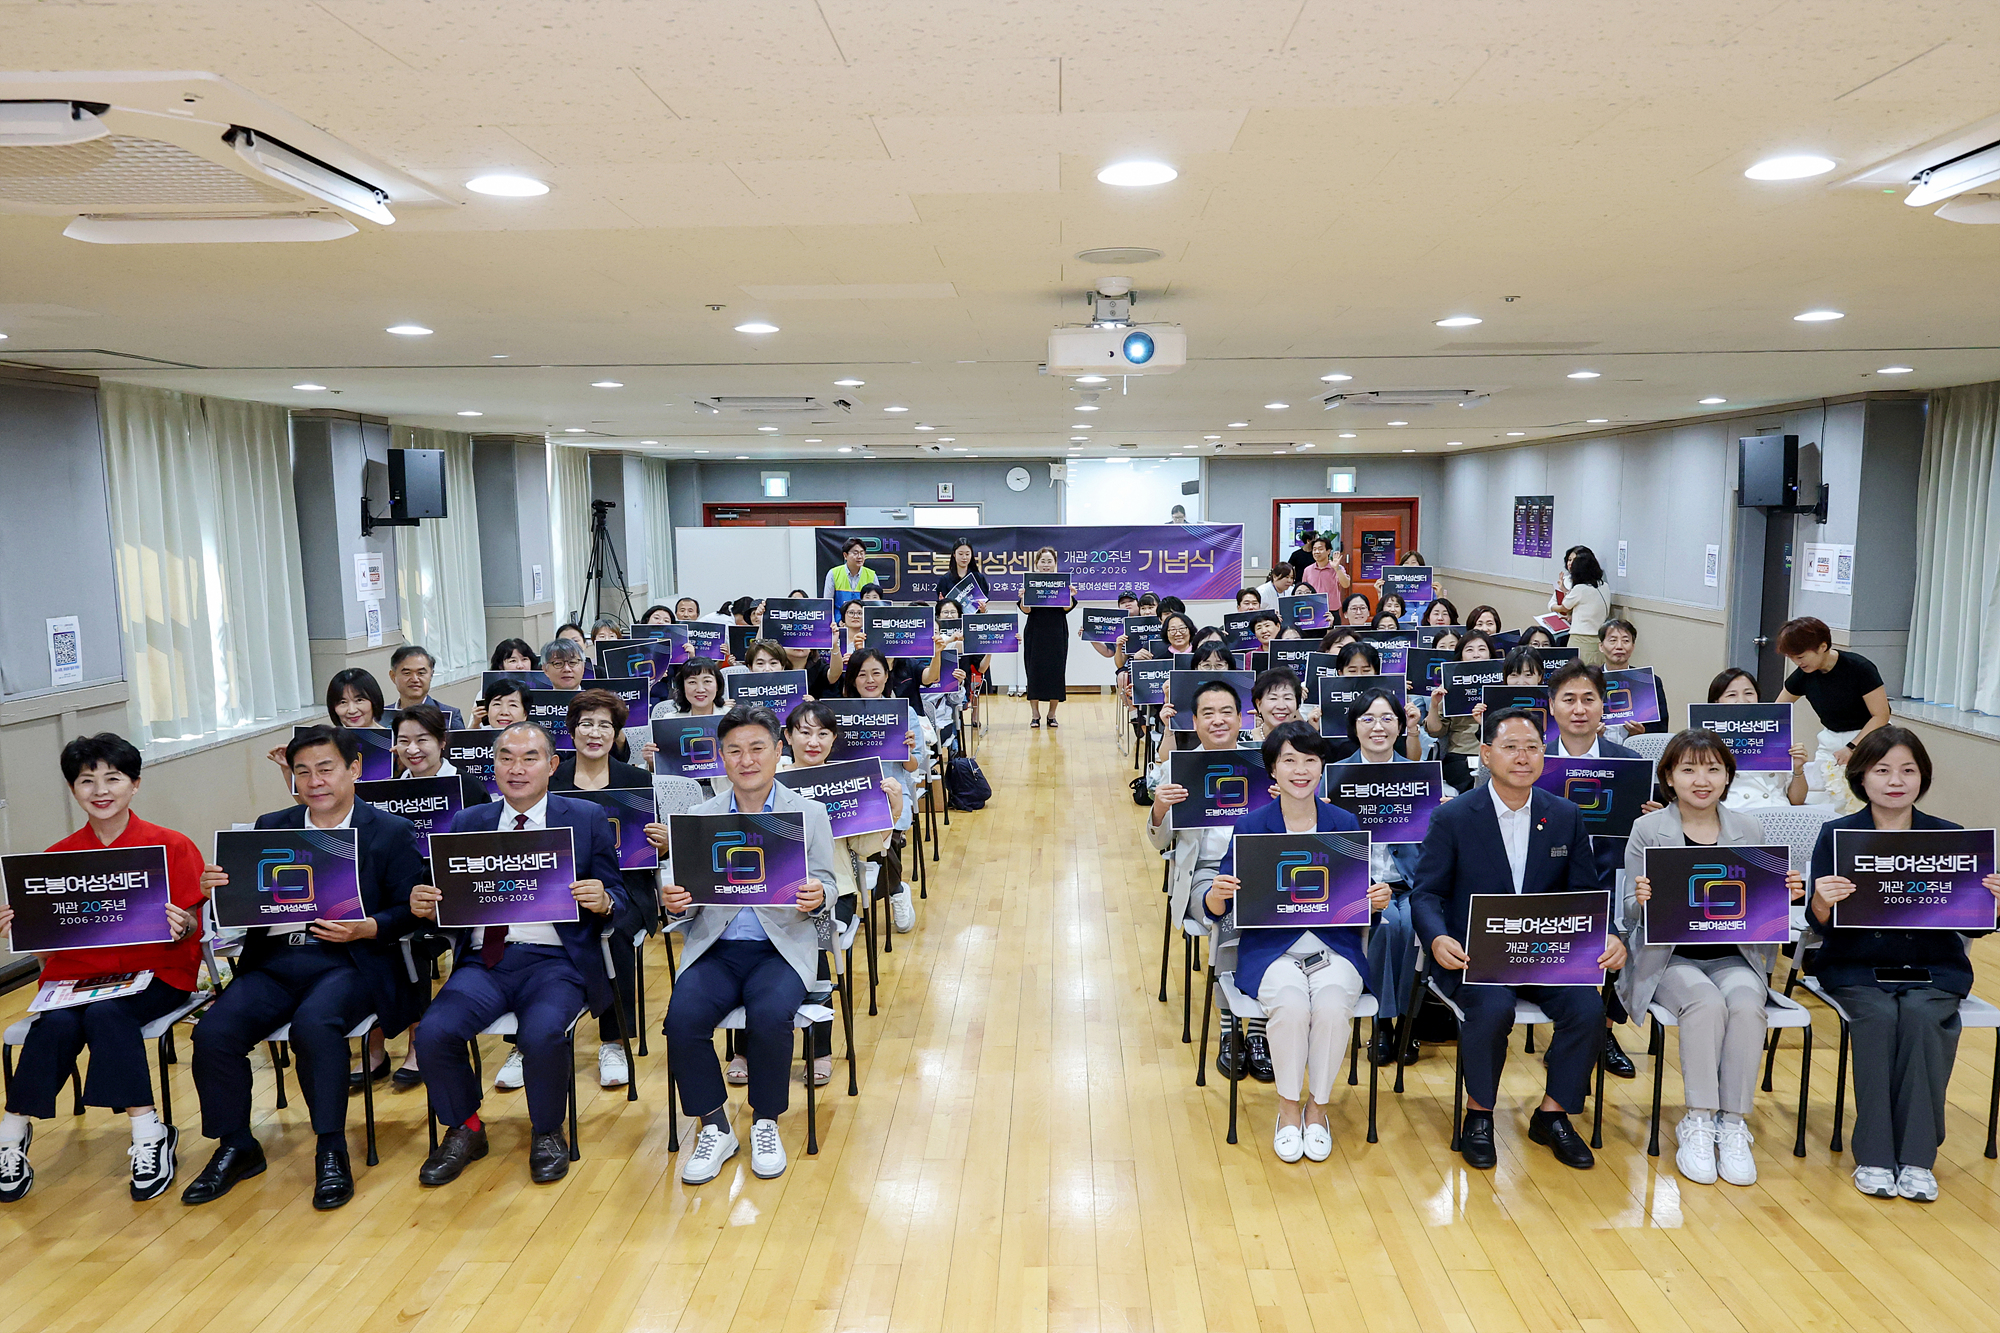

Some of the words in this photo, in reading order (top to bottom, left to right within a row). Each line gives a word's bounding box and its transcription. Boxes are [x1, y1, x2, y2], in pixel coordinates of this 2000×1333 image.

[1064, 550, 1088, 564] 개관
[1090, 550, 1132, 564] 20주년
[1138, 549, 1214, 574] 기념식
[1069, 567, 1128, 576] 2006-2026
[1387, 574, 1427, 582] 도봉여성센터
[912, 582, 930, 592] 일시:
[993, 582, 1009, 592] 오후
[1028, 580, 1066, 589] 도봉여성센터
[1118, 581, 1132, 591] 2층
[1134, 581, 1150, 592] 강당
[769, 610, 825, 621] 도봉여성센터
[780, 623, 793, 632] 개관
[793, 623, 814, 632] 20주년
[872, 619, 926, 629] 도봉여성센터
[969, 623, 1013, 632] 도봉여성센터
[1139, 670, 1170, 680] 도봉여성
[1452, 672, 1504, 686] 도봉여성센
[738, 684, 798, 698] 도봉여성센터
[764, 699, 787, 708] 20주년
[844, 731, 859, 740] 개관
[860, 730, 885, 740] 20주년
[1735, 738, 1764, 747] 20주년
[465, 764, 482, 774] 개관
[1340, 782, 1429, 799] 도봉여성센터
[827, 799, 858, 813] 20주년
[1358, 803, 1377, 815] 개관
[1378, 803, 1412, 815] 20주년
[1205, 807, 1249, 818] 도봉여성센터
[1362, 816, 1409, 824] 2006-2026
[448, 852, 557, 875] 도봉여성센터
[1854, 855, 1978, 874] 도봉여성센터
[24, 871, 149, 896] 도봉여성센터
[472, 880, 495, 893] 개관
[497, 878, 538, 892] 20주년
[714, 883, 767, 894] 도봉여성센터
[1878, 881, 1904, 894] 개관
[1905, 880, 1952, 894] 20주년
[478, 893, 535, 904] 2006-2026
[1883, 896, 1948, 905] 2006-2026
[52, 902, 79, 915] 개관
[81, 898, 127, 914] 20주년
[260, 903, 317, 914] 도봉여성센터
[1277, 903, 1329, 913] 도봉여성센터
[59, 914, 124, 926] 2006-2026
[1485, 915, 1592, 936] 도봉여성센터
[1689, 920, 1746, 931] 도봉여성센터
[1505, 941, 1529, 954] 개관
[1530, 941, 1571, 954] 20주년
[1509, 955, 1566, 965] 2006-2026
